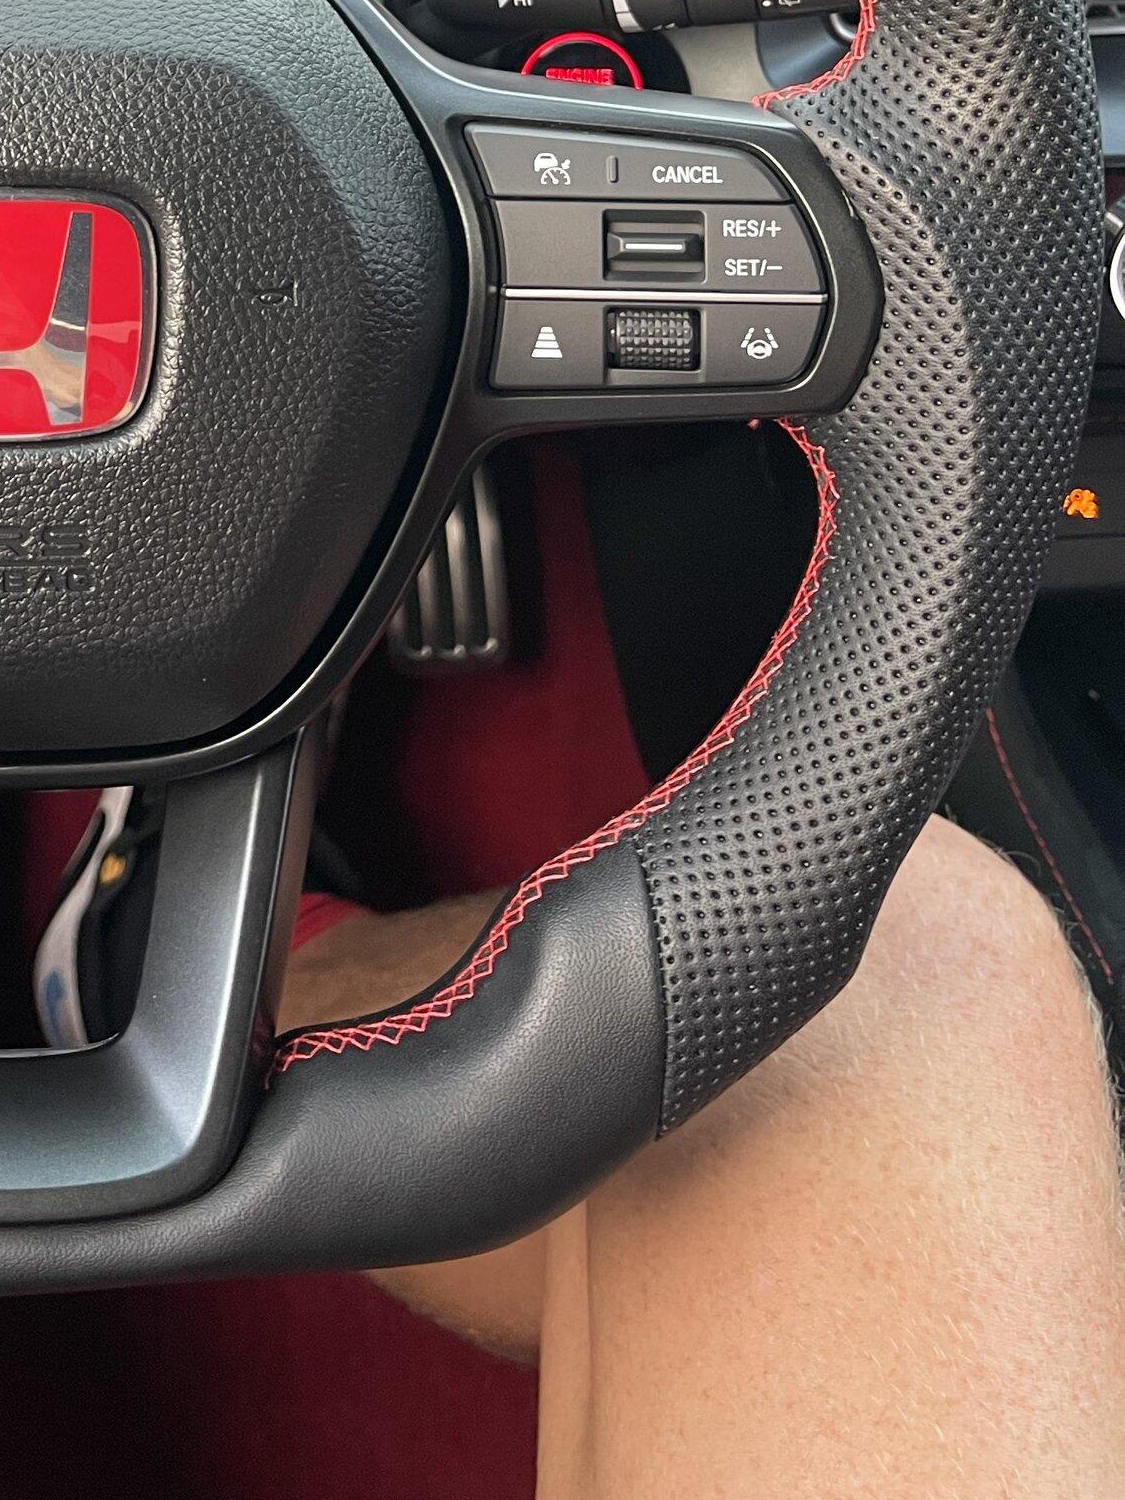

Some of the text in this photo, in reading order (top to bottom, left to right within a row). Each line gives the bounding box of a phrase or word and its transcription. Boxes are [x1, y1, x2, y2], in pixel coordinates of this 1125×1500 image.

[545, 67, 614, 86] ENGINE
[651, 165, 724, 184] CANCEL
[722, 218, 783, 238] RES/+
